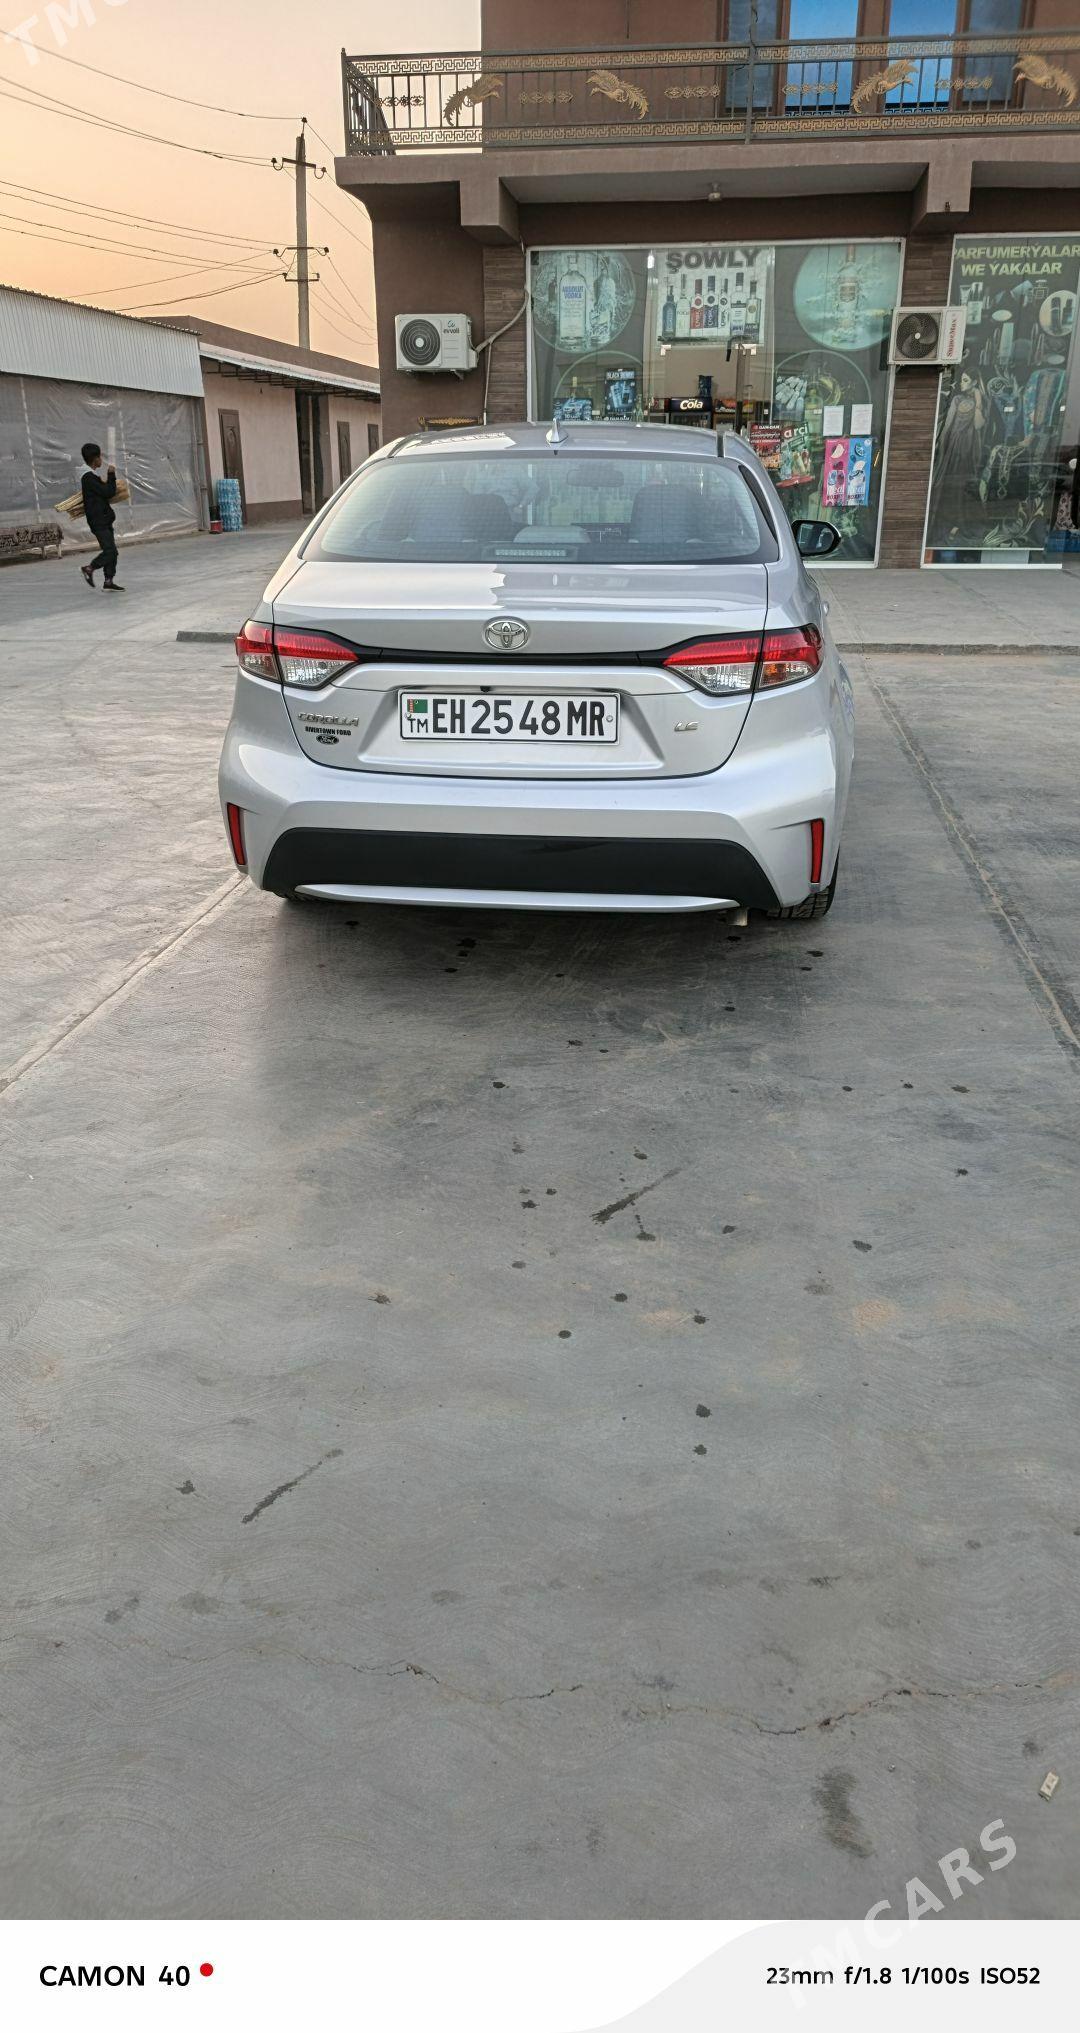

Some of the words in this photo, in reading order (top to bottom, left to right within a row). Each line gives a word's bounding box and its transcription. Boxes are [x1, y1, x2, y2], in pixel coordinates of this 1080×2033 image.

[961, 263, 985, 276] WE
[679, 399, 704, 411] Cola
[298, 712, 360, 727] COROLLA
[410, 718, 429, 734] TM
